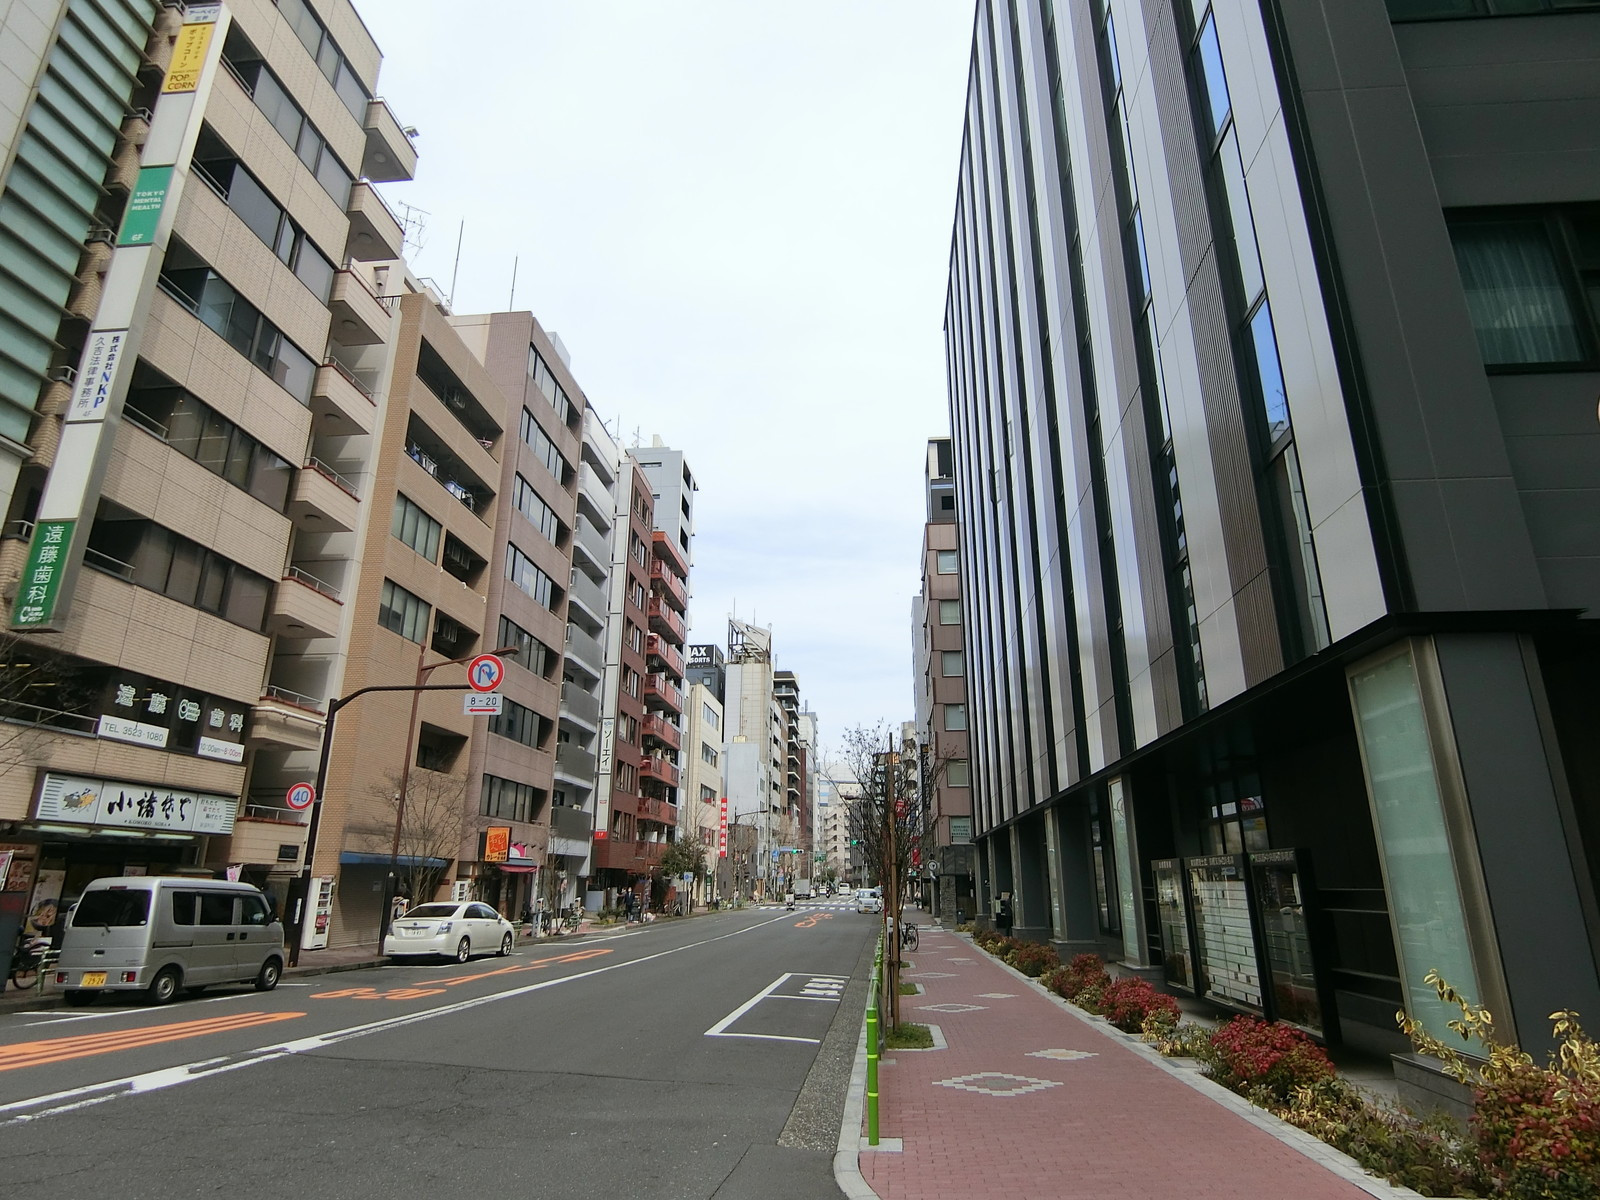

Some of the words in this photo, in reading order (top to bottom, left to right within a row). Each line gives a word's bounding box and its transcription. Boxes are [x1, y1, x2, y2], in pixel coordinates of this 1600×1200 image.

[168, 81, 195, 90] CORN
[131, 203, 161, 211] HEALTH
[131, 233, 143, 241] 6F
[27, 525, 65, 604] 遠藤歯科
[690, 647, 707, 657] AX
[104, 722, 119, 734] TEL
[602, 730, 612, 766] ソーエイ
[293, 790, 309, 803] 40
